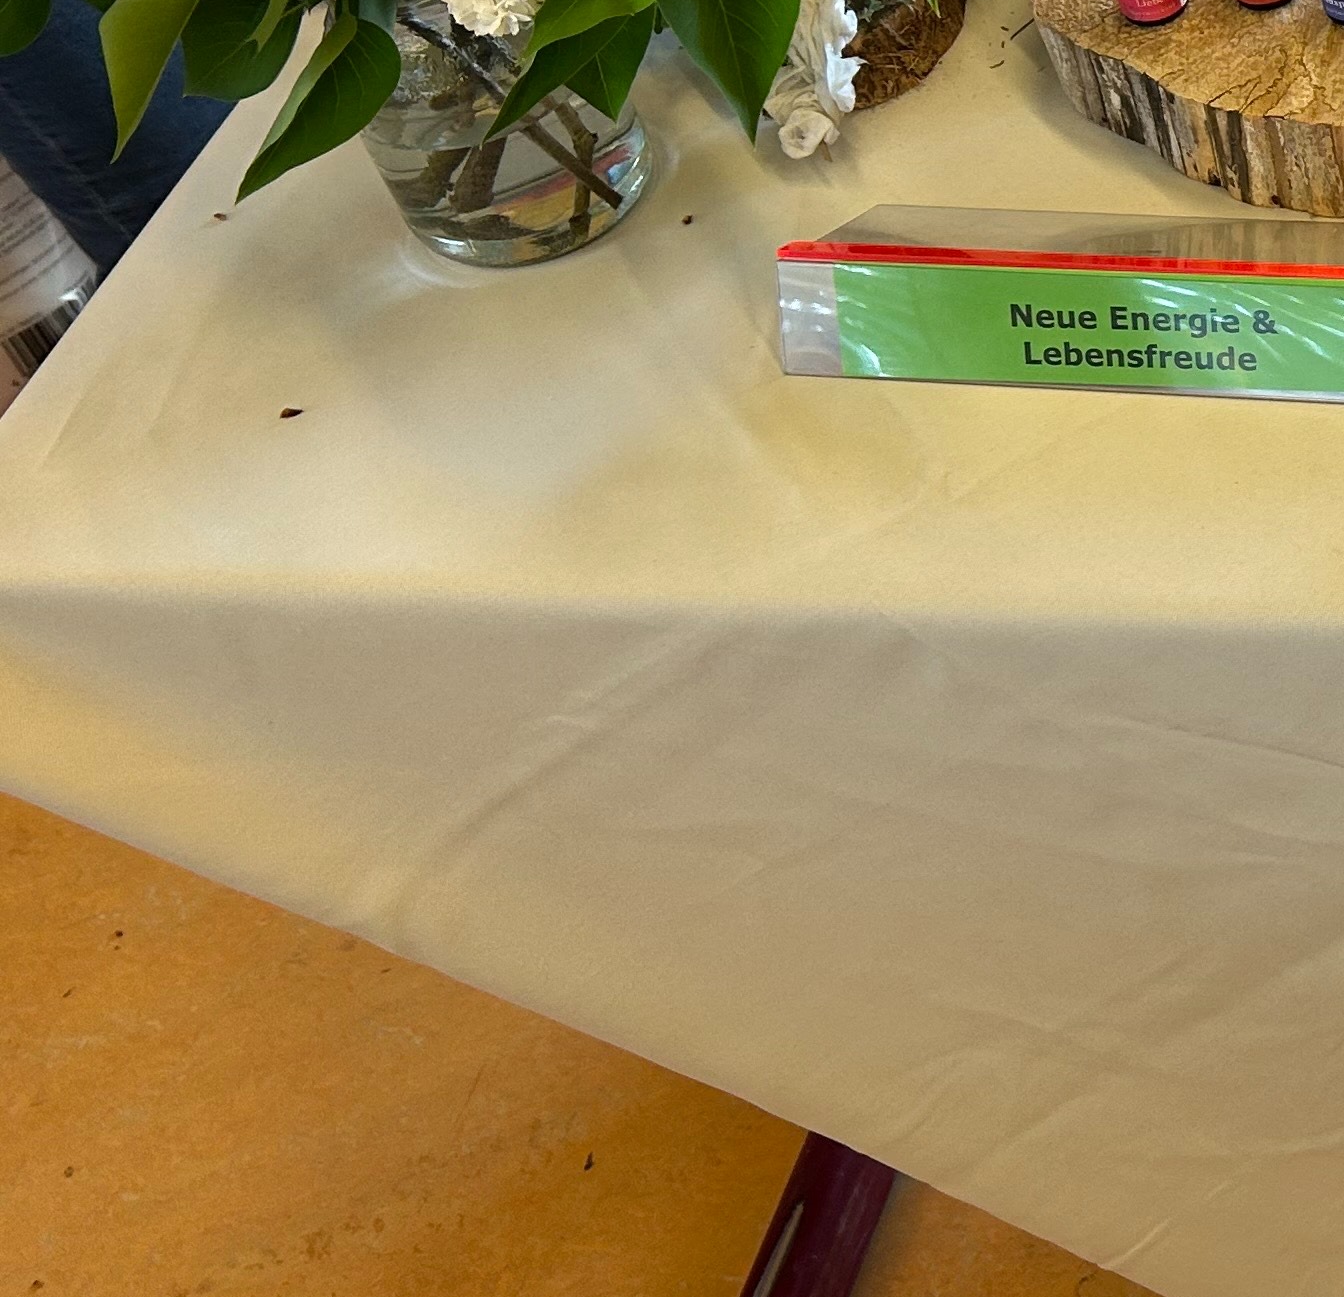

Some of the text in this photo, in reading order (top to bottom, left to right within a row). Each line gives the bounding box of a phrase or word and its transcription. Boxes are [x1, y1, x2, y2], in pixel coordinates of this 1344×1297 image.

[1010, 303, 1280, 339] Neue Energie &
[1023, 341, 1258, 372] Lebensfreude
